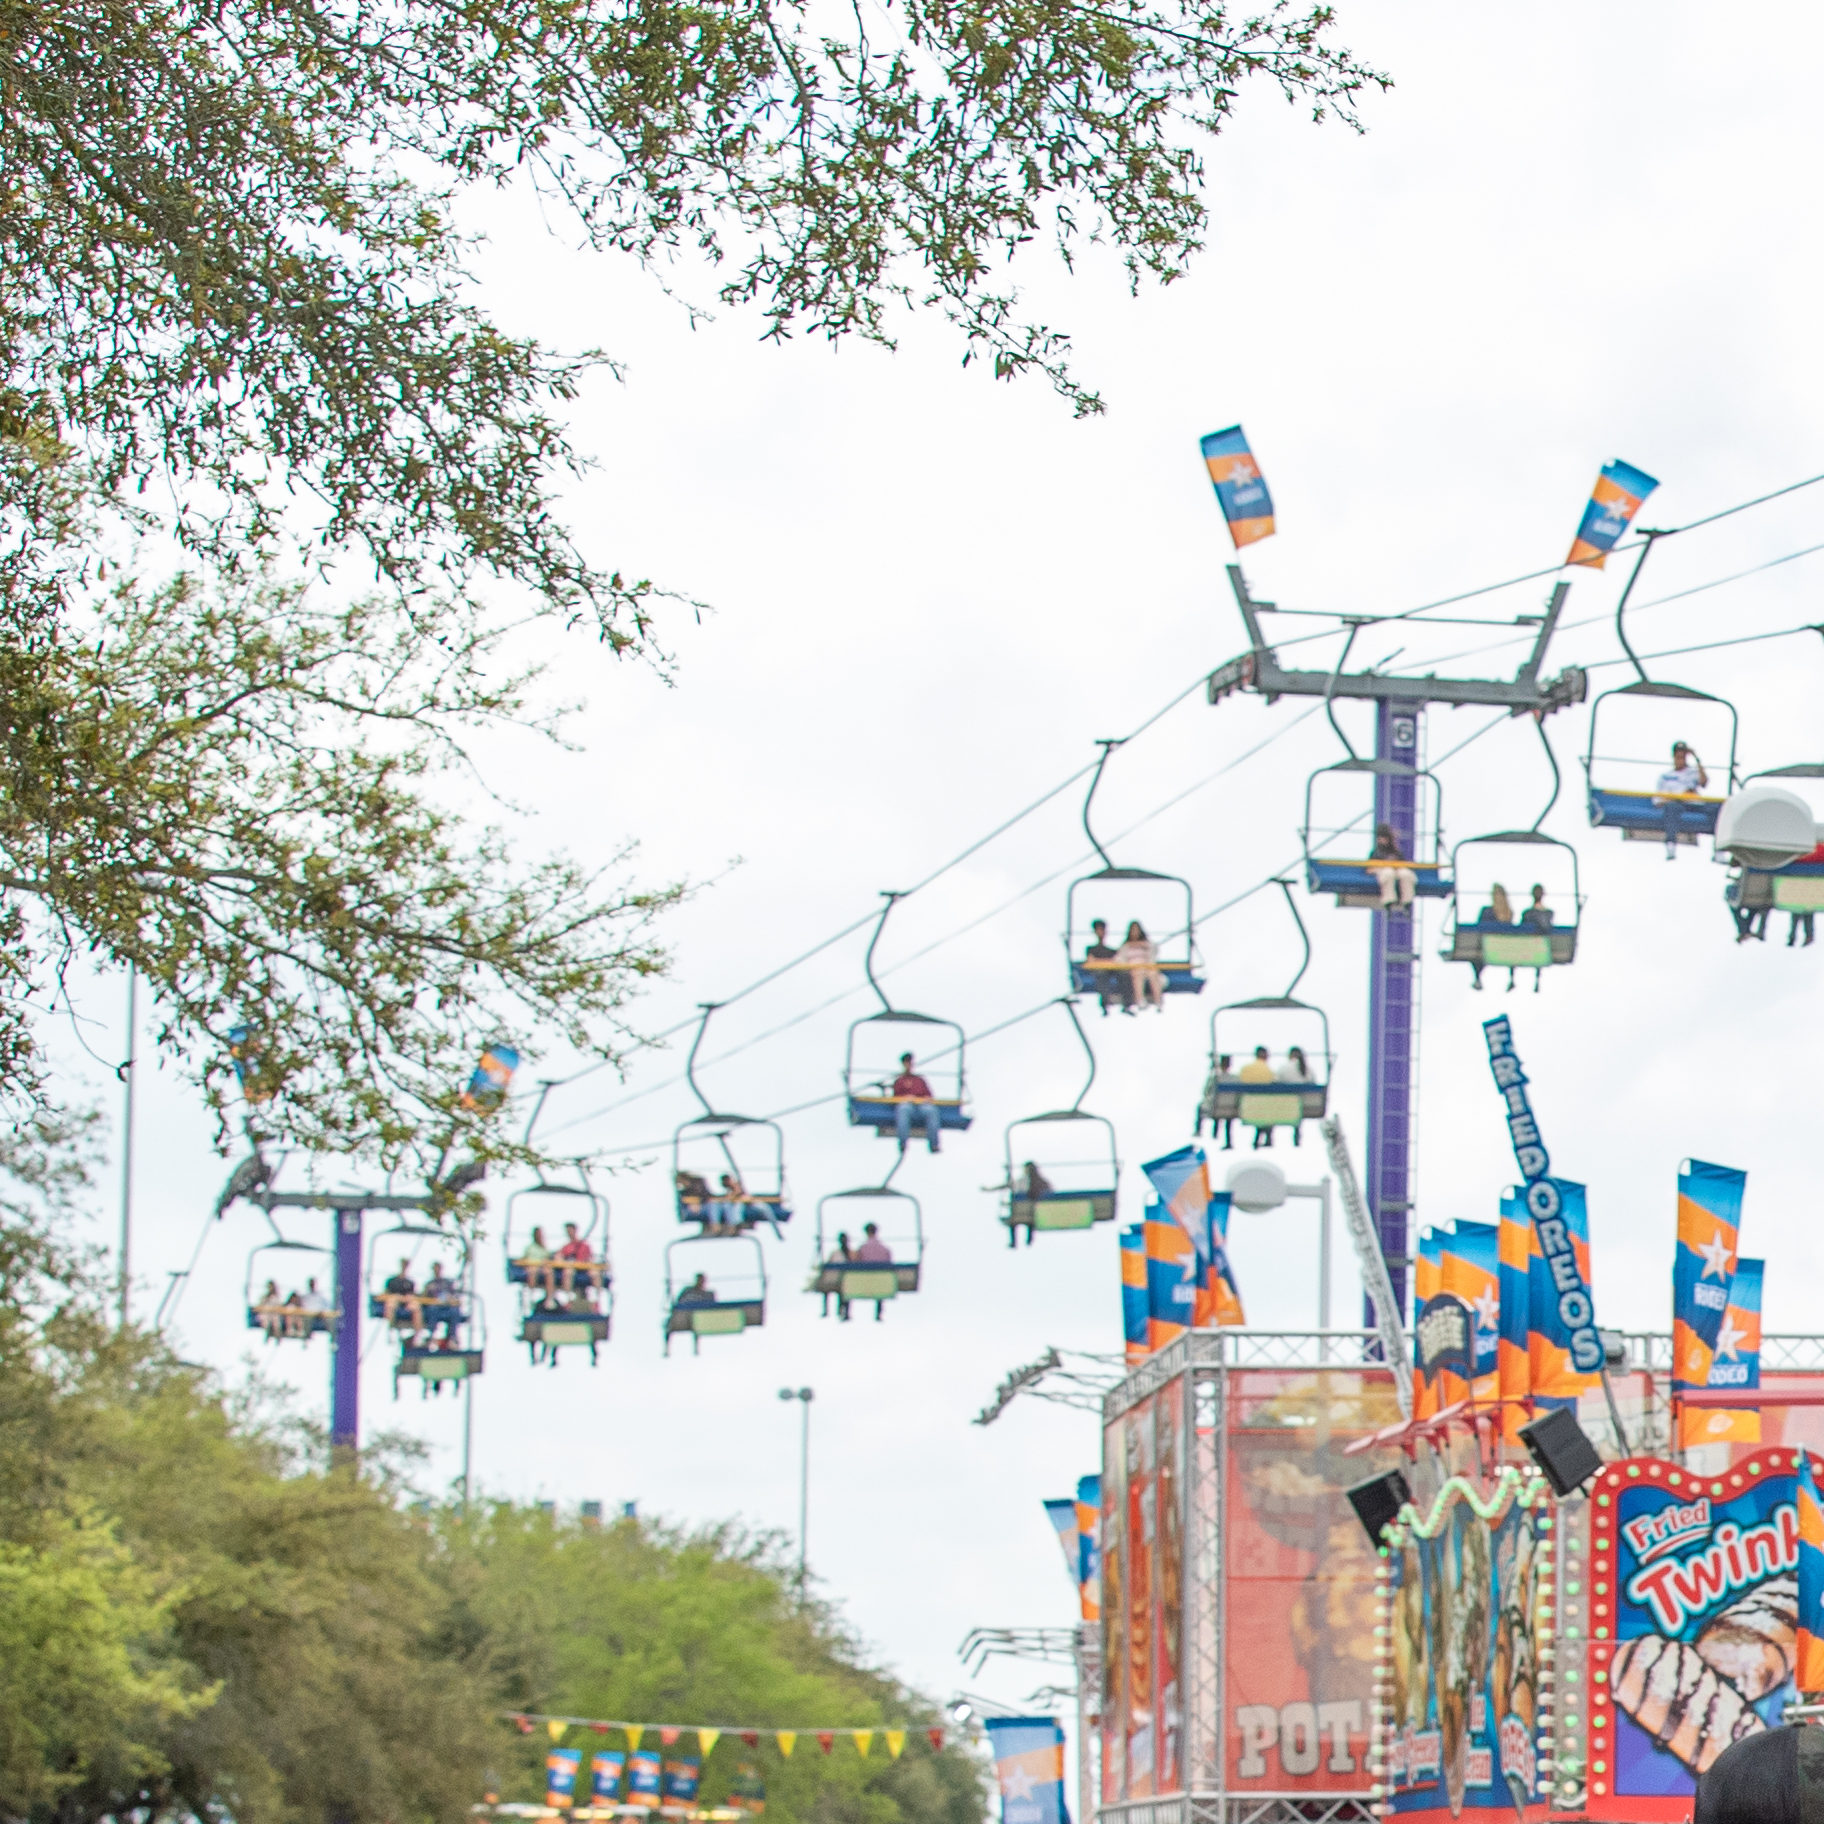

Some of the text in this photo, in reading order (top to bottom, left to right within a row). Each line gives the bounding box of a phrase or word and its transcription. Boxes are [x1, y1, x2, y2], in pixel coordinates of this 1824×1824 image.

[1483, 1014, 1551, 1181] FRIED
[1526, 1176, 1606, 1374] OREOS
[1623, 1499, 1712, 1553] Fried
